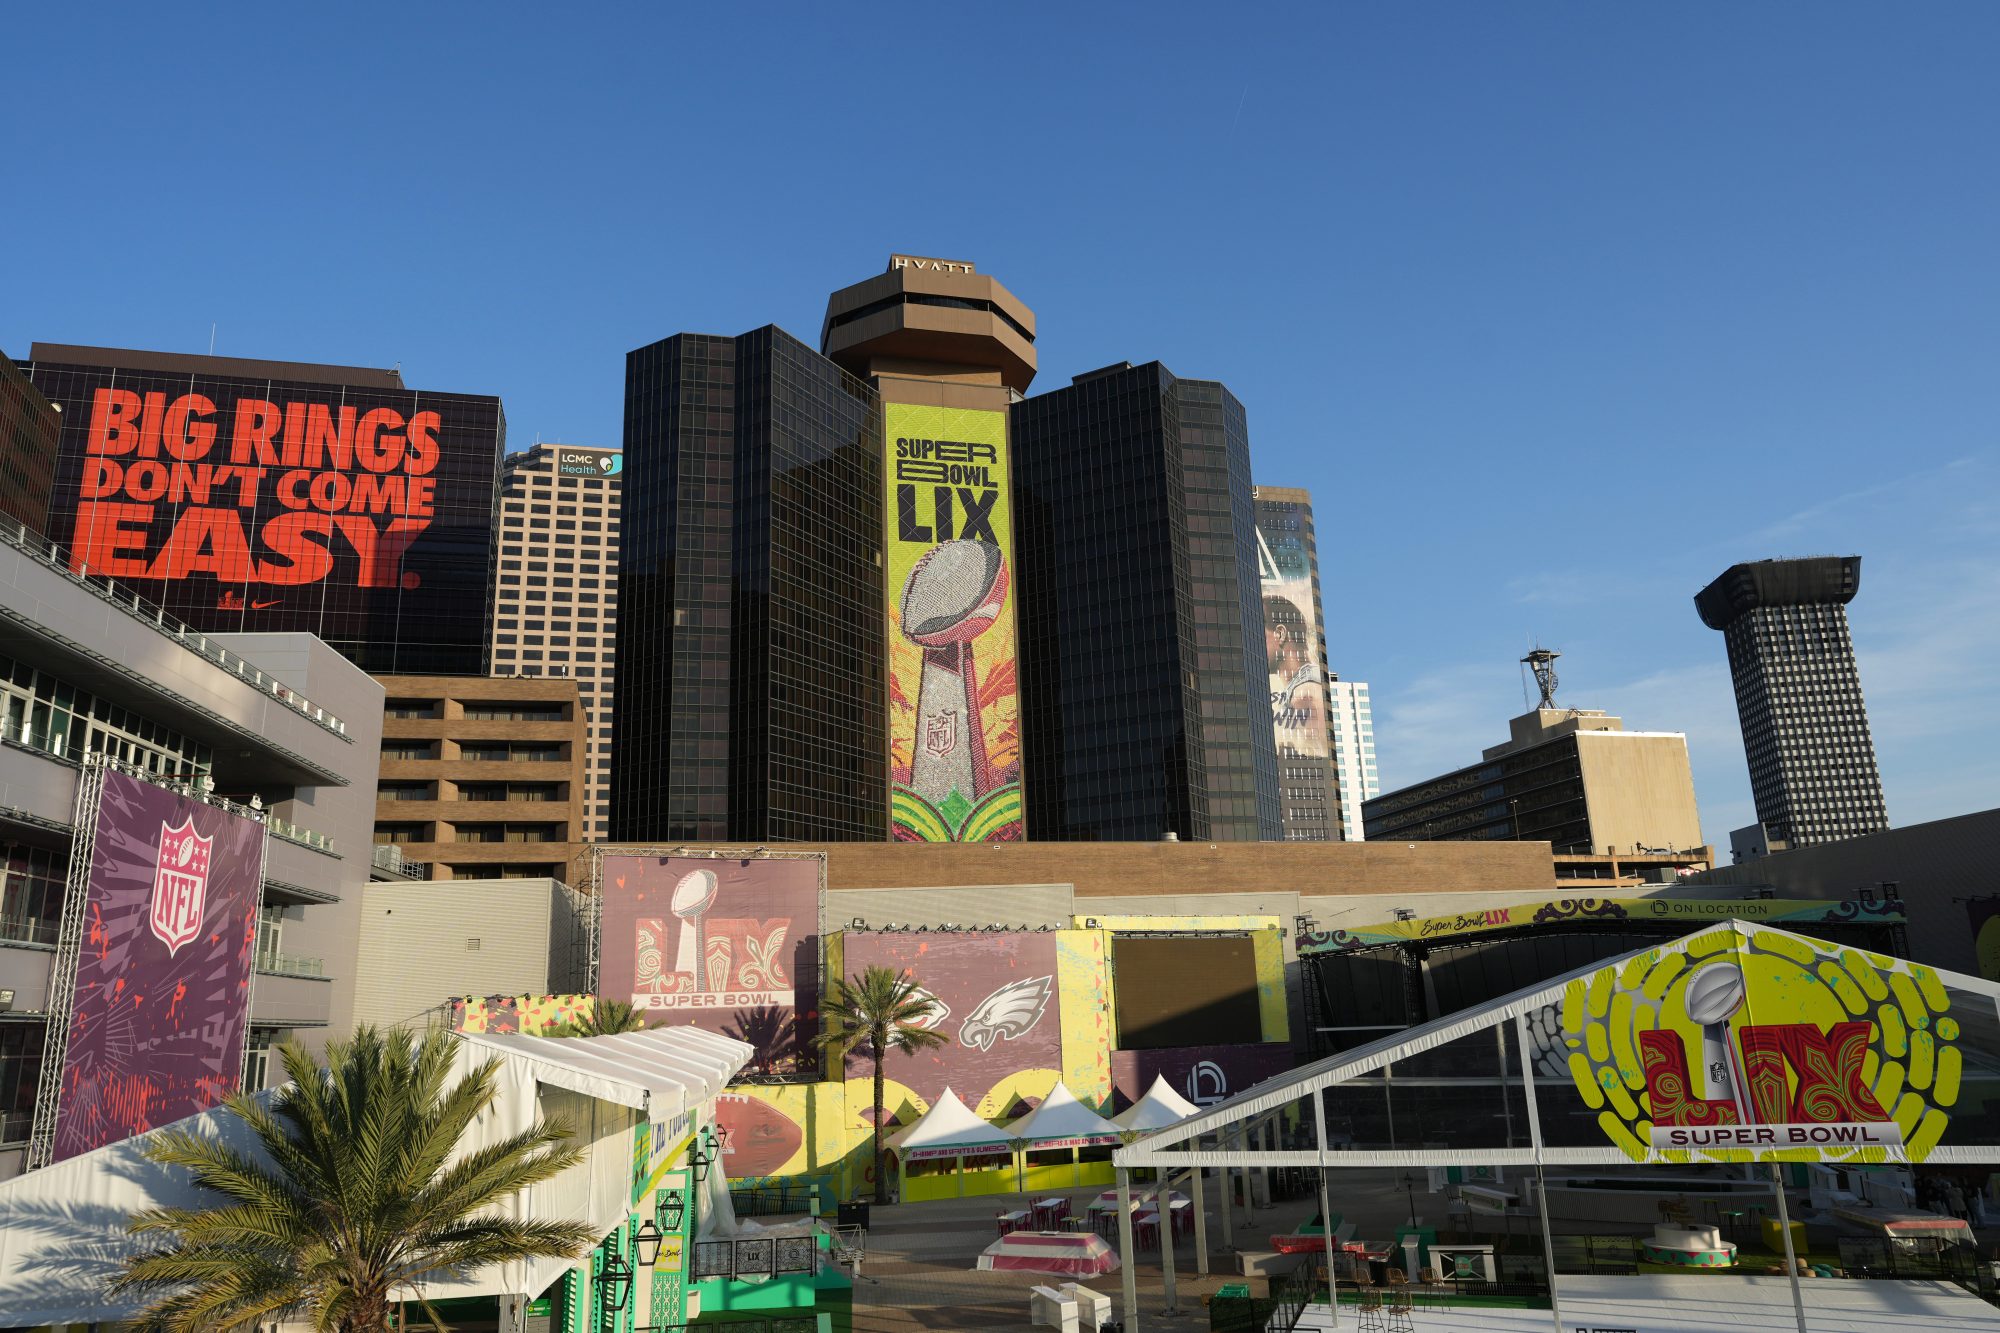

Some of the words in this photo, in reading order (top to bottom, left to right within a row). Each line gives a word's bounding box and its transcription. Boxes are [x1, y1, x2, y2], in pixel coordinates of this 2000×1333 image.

[86, 388, 218, 461] BIG
[230, 398, 442, 476] RINGS
[562, 453, 593, 464] LCMC
[896, 437, 998, 464] SUPER
[560, 464, 597, 475] Health
[896, 459, 999, 489] BOWL
[79, 457, 267, 508] DON'T
[276, 469, 437, 517] COME
[896, 483, 1000, 547] LIX
[68, 501, 433, 589] EASY.
[157, 873, 198, 936] NFL
[1673, 904, 1693, 913] ON
[1698, 904, 1768, 915] LOCATION
[1420, 920, 1452, 936] Super
[1453, 912, 1488, 931] Bowl
[1485, 908, 1511, 926] LIX
[649, 995, 717, 1008] SUPER
[723, 993, 779, 1006] BOWL
[1670, 1128, 1776, 1146] SUPER
[1787, 1126, 1880, 1143] BOWL
